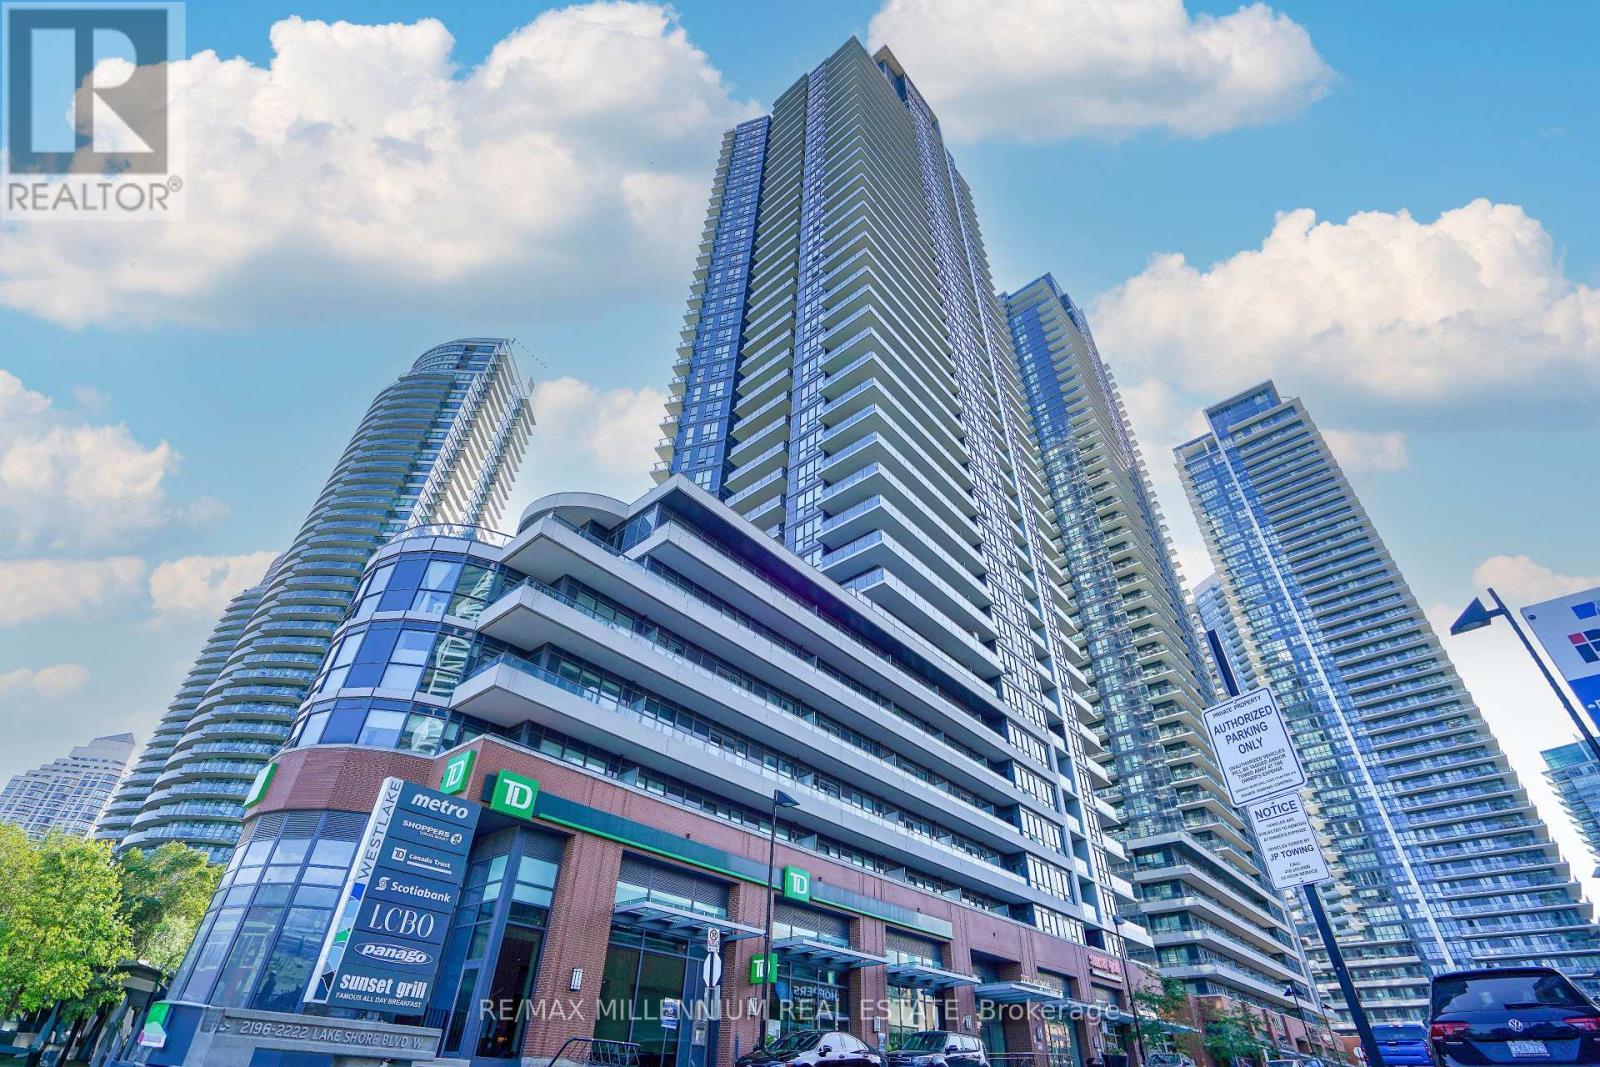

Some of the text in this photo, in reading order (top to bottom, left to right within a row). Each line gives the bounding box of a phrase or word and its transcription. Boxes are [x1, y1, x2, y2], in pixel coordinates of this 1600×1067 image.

[1234, 695, 1261, 710] PROPERTY
[1213, 706, 1272, 736] AUTHORIZED
[1225, 722, 1268, 744] PARKING
[1238, 737, 1263, 754] ONLY
[446, 760, 465, 788] TD
[503, 778, 532, 810] TD
[411, 794, 468, 819] metro
[1254, 800, 1298, 819] NOTICE
[358, 780, 400, 878] WESTLAKE
[402, 820, 450, 838] SHOPPERS
[409, 854, 432, 864] Canada
[434, 859, 450, 868] Trust
[1270, 844, 1314, 861] JP TOWING
[391, 882, 451, 902] Scotiabank
[790, 872, 807, 894] TD
[368, 904, 434, 938] LCBO
[362, 944, 427, 963] panago
[754, 960, 770, 978] TD
[340, 974, 427, 998] sunset grill
[336, 992, 362, 1000] FAMOUS
[388, 998, 422, 1008] BREAKFAST
[240, 1021, 309, 1039] 2196-2222
[312, 1028, 342, 1042] LAKE
[343, 1032, 380, 1045] SHORE
[382, 1034, 408, 1047] BLVD
